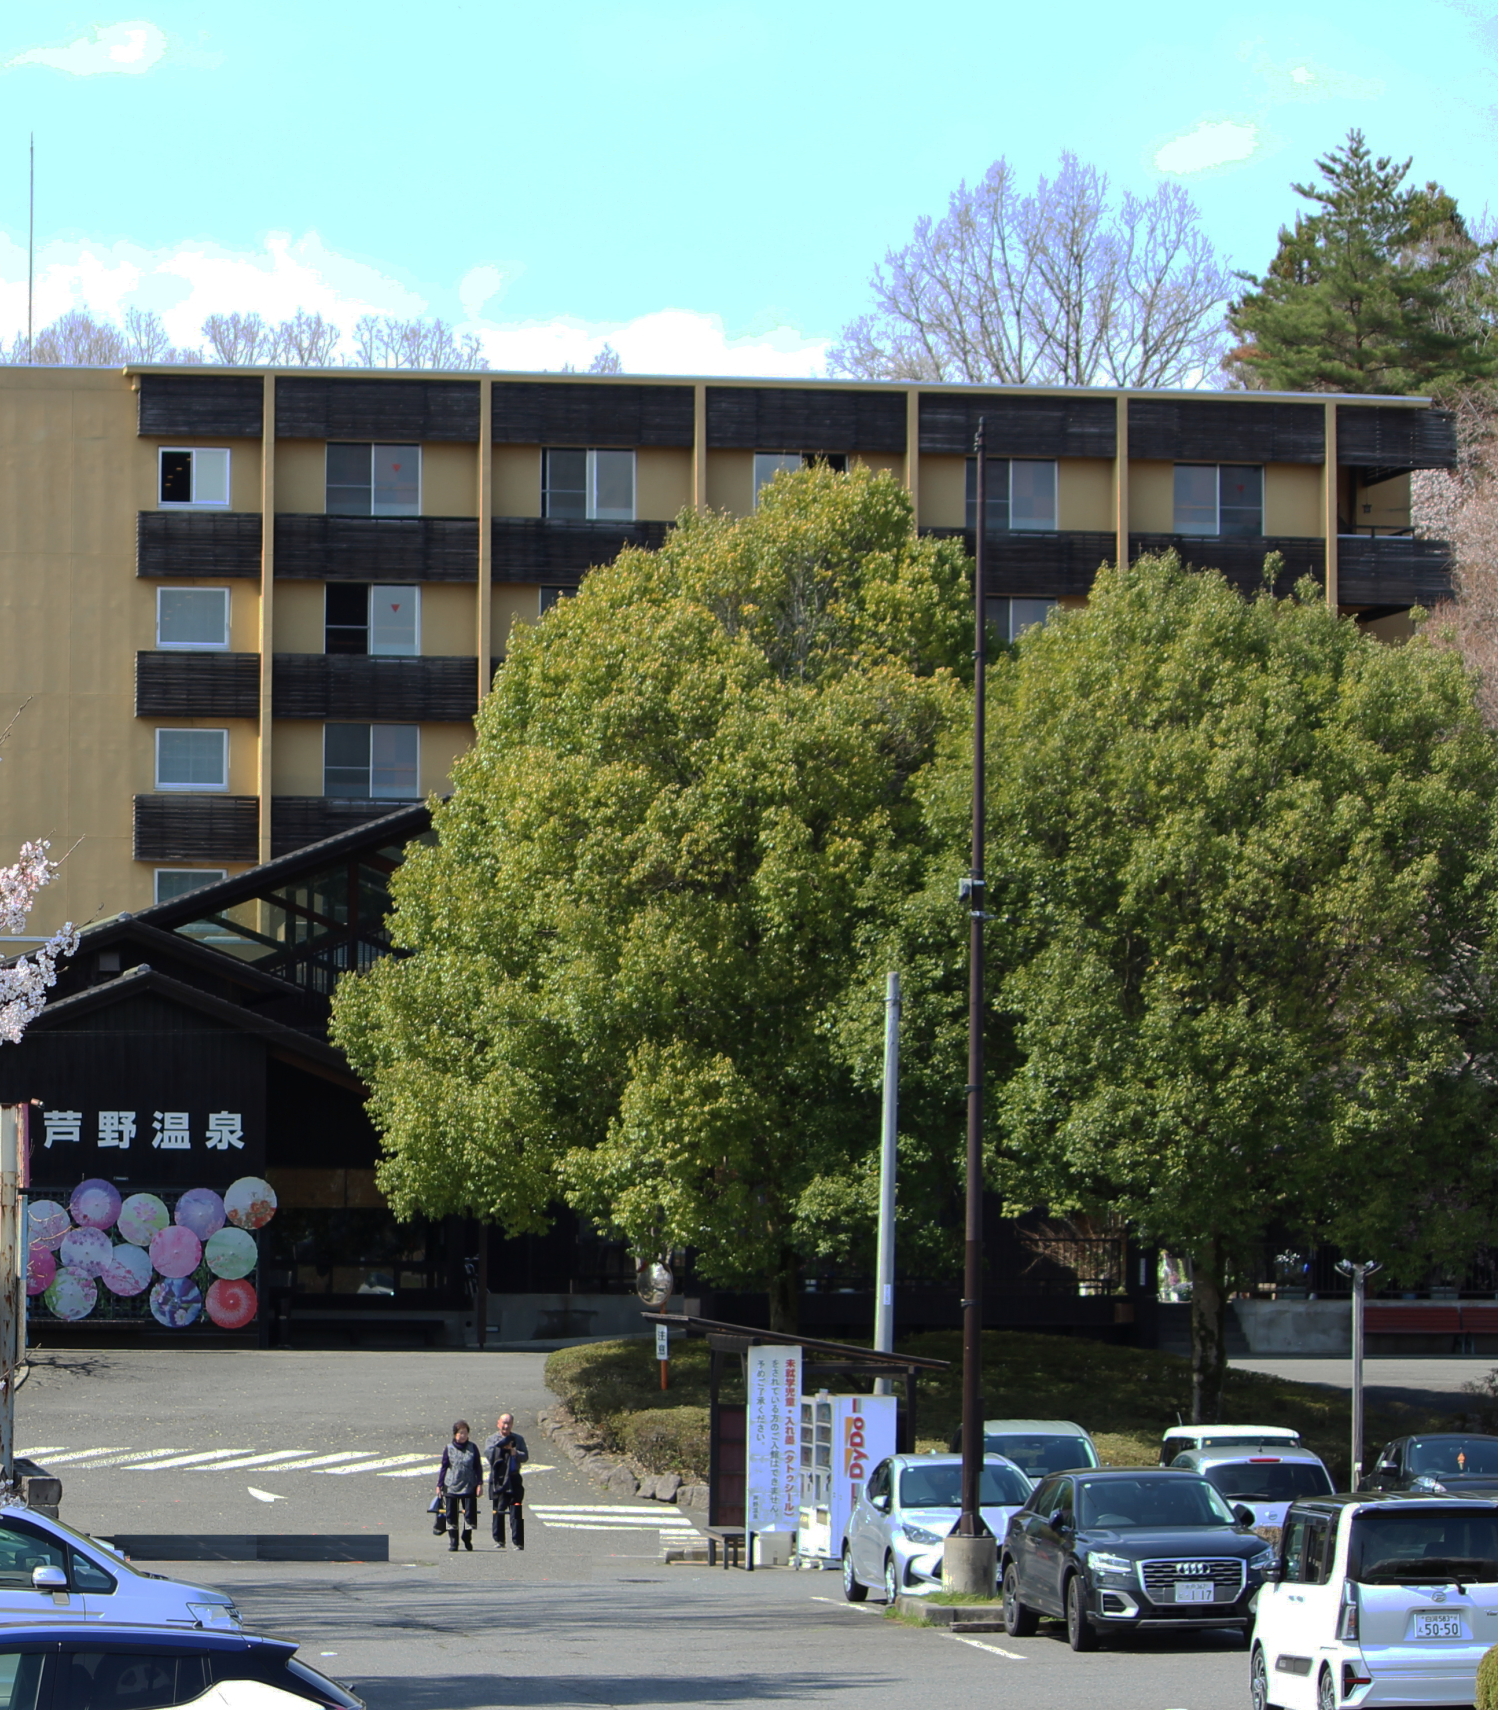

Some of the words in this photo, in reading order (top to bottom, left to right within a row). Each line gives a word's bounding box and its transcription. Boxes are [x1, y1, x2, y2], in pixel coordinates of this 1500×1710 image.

[43, 1110, 245, 1150] 芦野温泉
[657, 1330, 666, 1355] 注意
[756, 1359, 766, 1445] 予めご了承ください。
[849, 1417, 869, 1479] DyDo
[1425, 1623, 1459, 1635] 50-50
